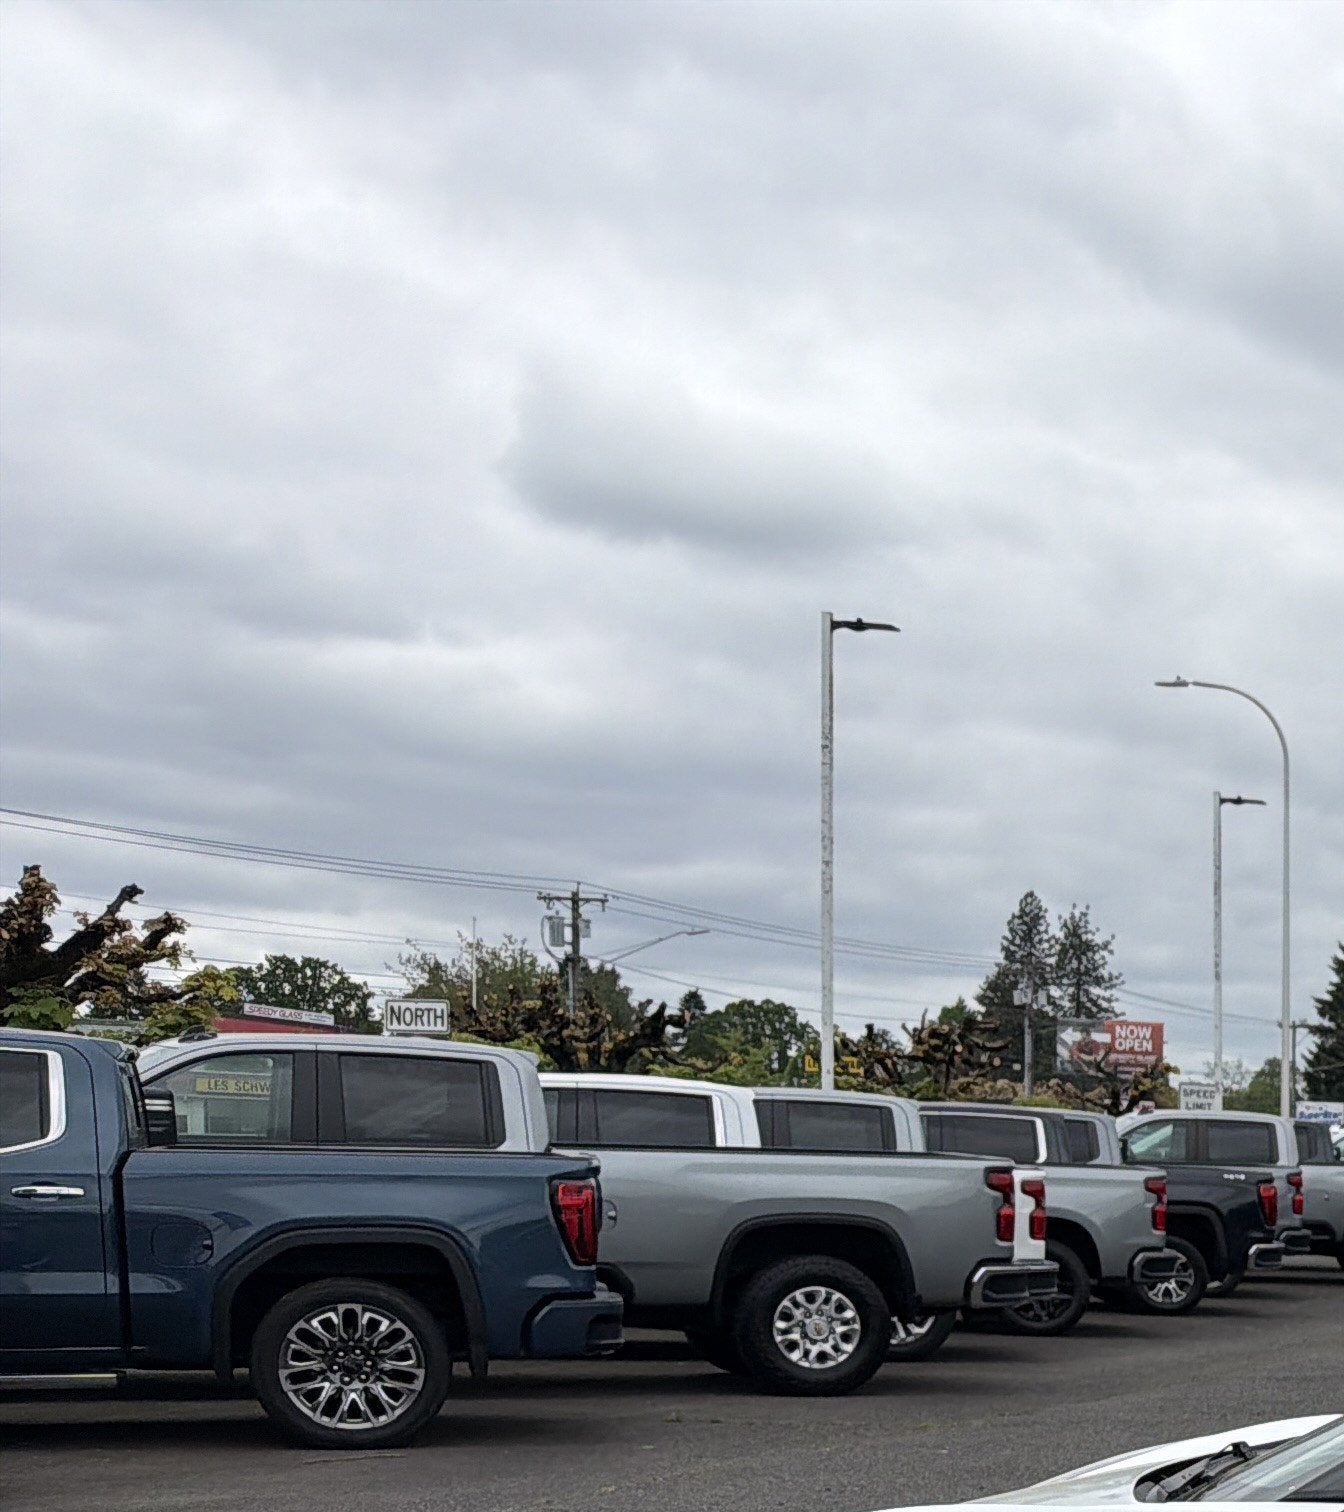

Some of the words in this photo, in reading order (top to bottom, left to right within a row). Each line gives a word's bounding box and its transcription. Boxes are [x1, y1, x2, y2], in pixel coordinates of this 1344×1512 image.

[248, 1004, 279, 1017] SPEEDY
[279, 1008, 304, 1021] GLASS
[389, 1004, 446, 1028] NORTH
[1114, 1024, 1153, 1039] NOW
[1114, 1038, 1153, 1053] OPEN
[207, 1078, 229, 1091] LES
[1185, 1101, 1212, 1111] LIMIT
